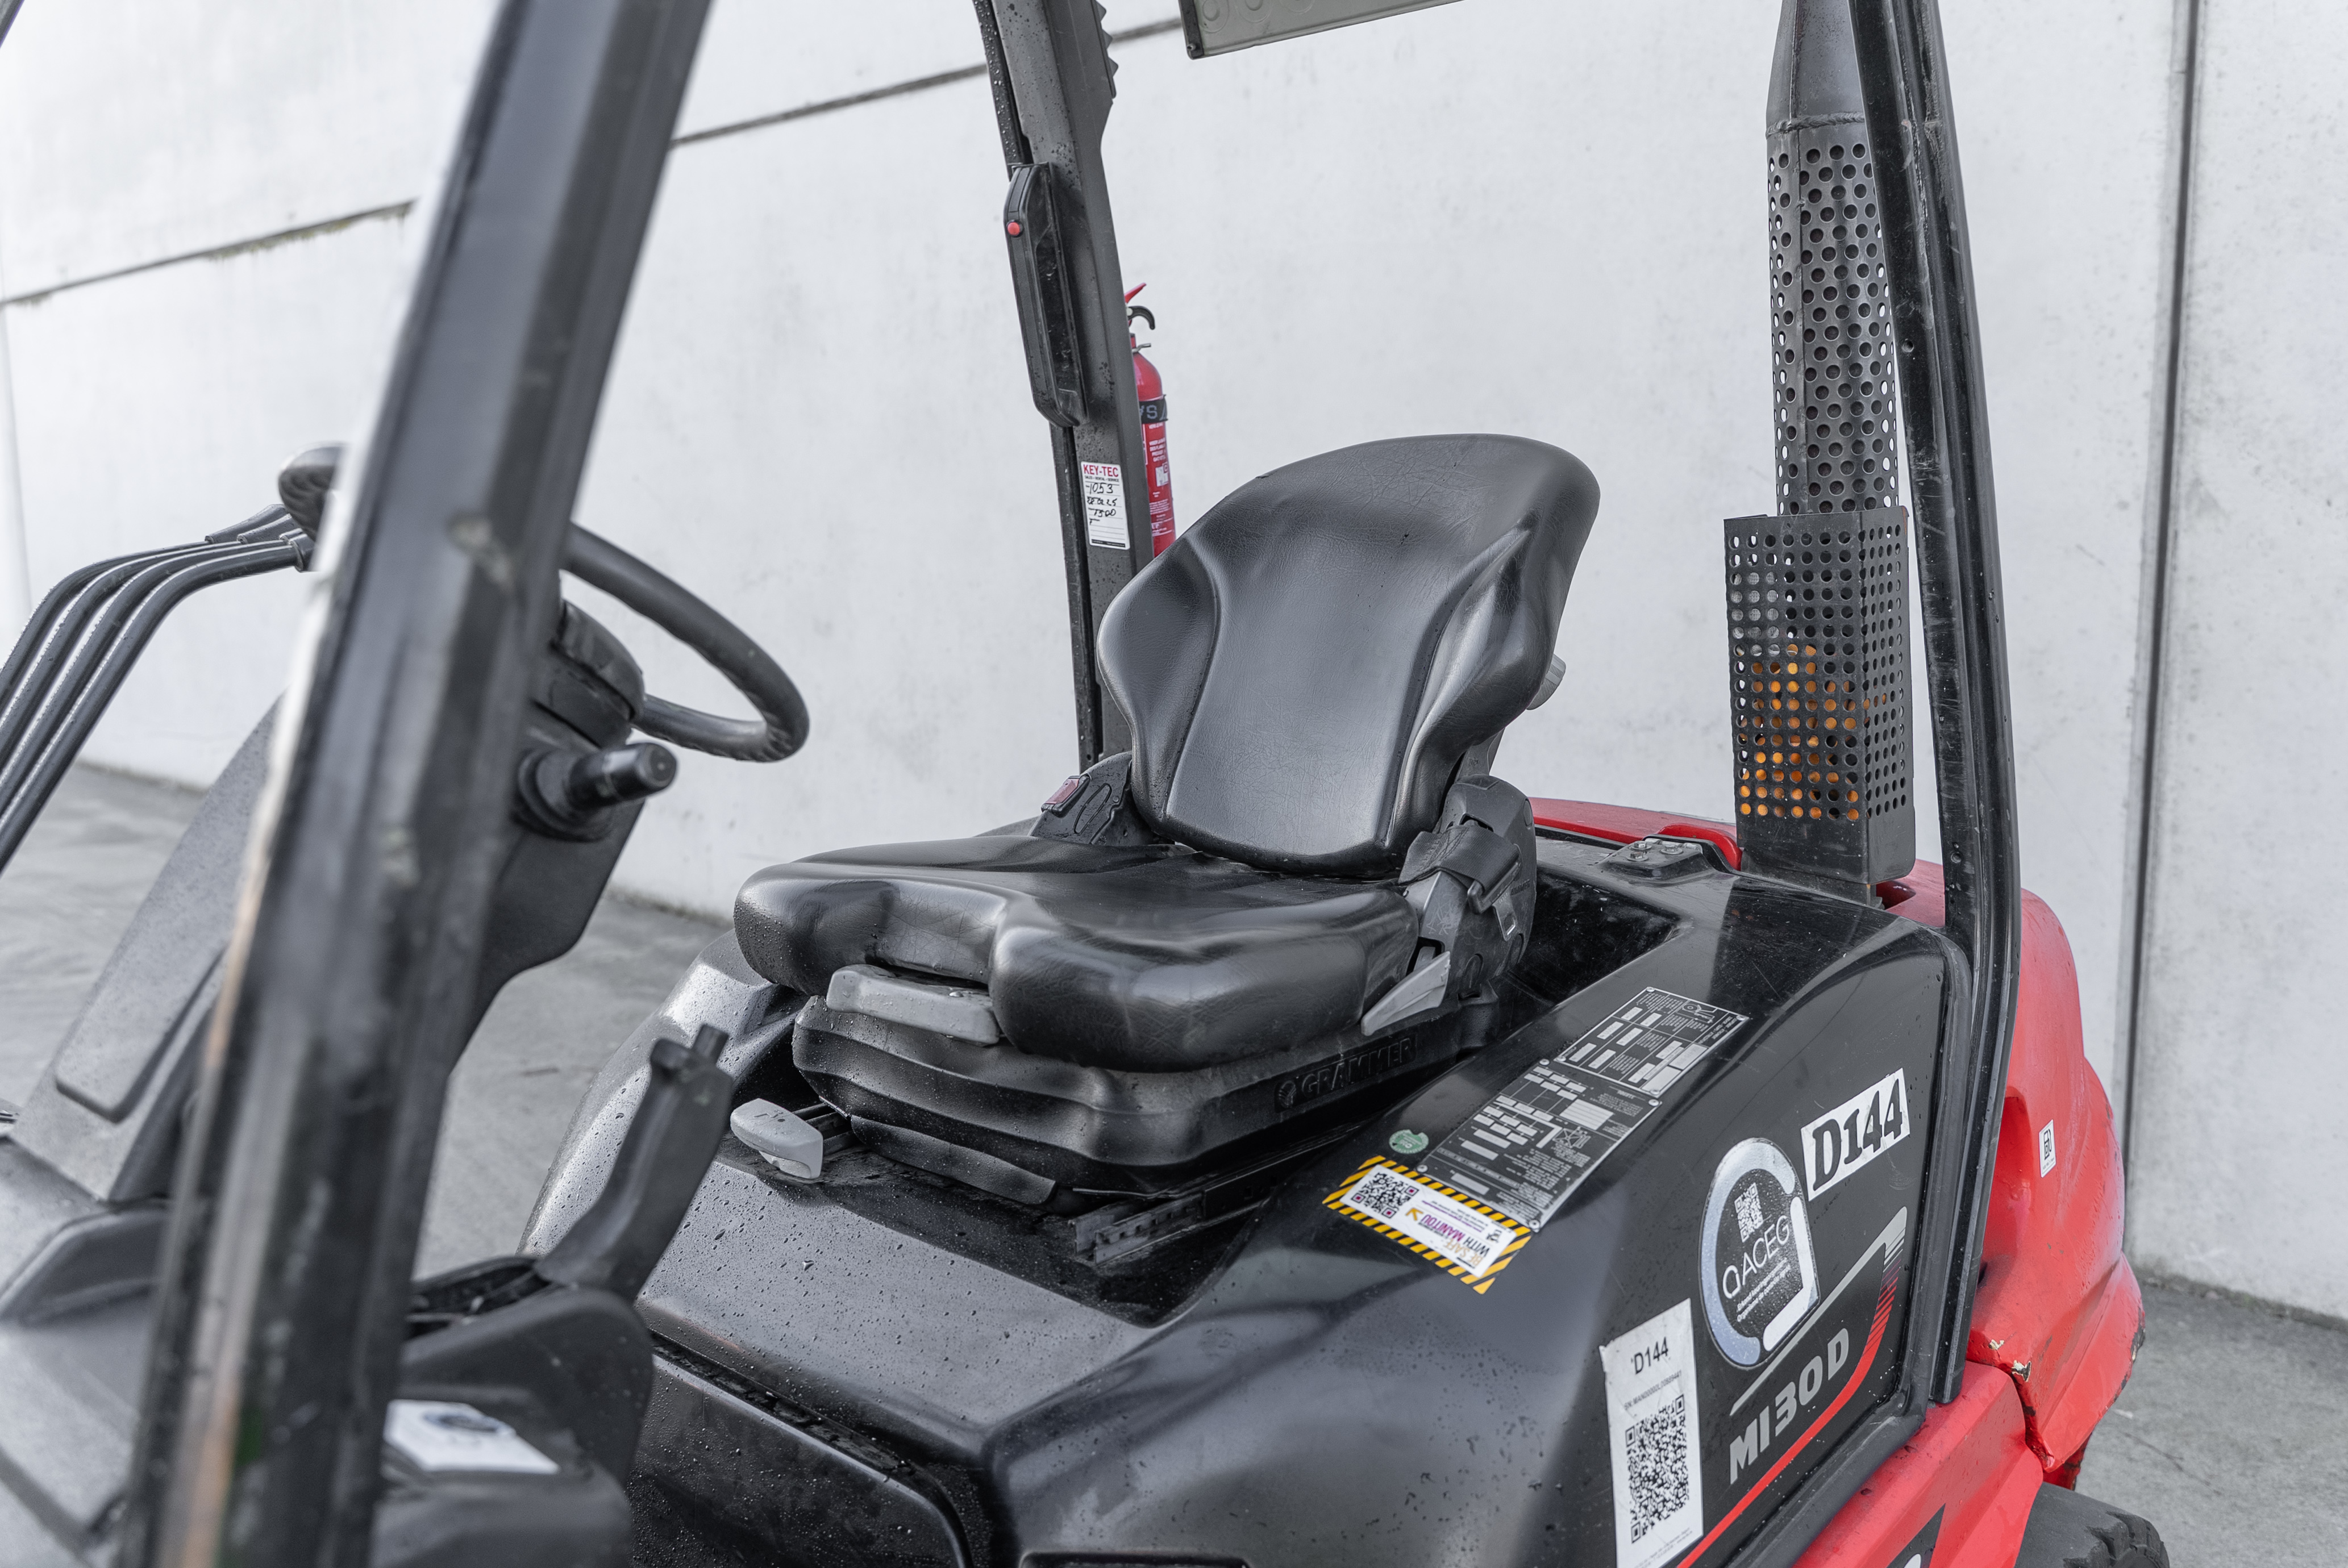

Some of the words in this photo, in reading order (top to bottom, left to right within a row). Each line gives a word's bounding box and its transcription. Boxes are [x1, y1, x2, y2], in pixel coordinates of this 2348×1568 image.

[1083, 464, 1118, 477] KEY-TEC
[1302, 1037, 1414, 1099] GRAMMER
[1812, 1078, 1902, 1191] D144
[1421, 1214, 1466, 1242] MANITOU
[1443, 1238, 1471, 1257] SAFE
[1463, 1237, 1489, 1257] WITH
[1468, 1253, 1484, 1266] BE
[1723, 1215, 1789, 1299] QACEG
[1634, 1336, 1668, 1375] D144
